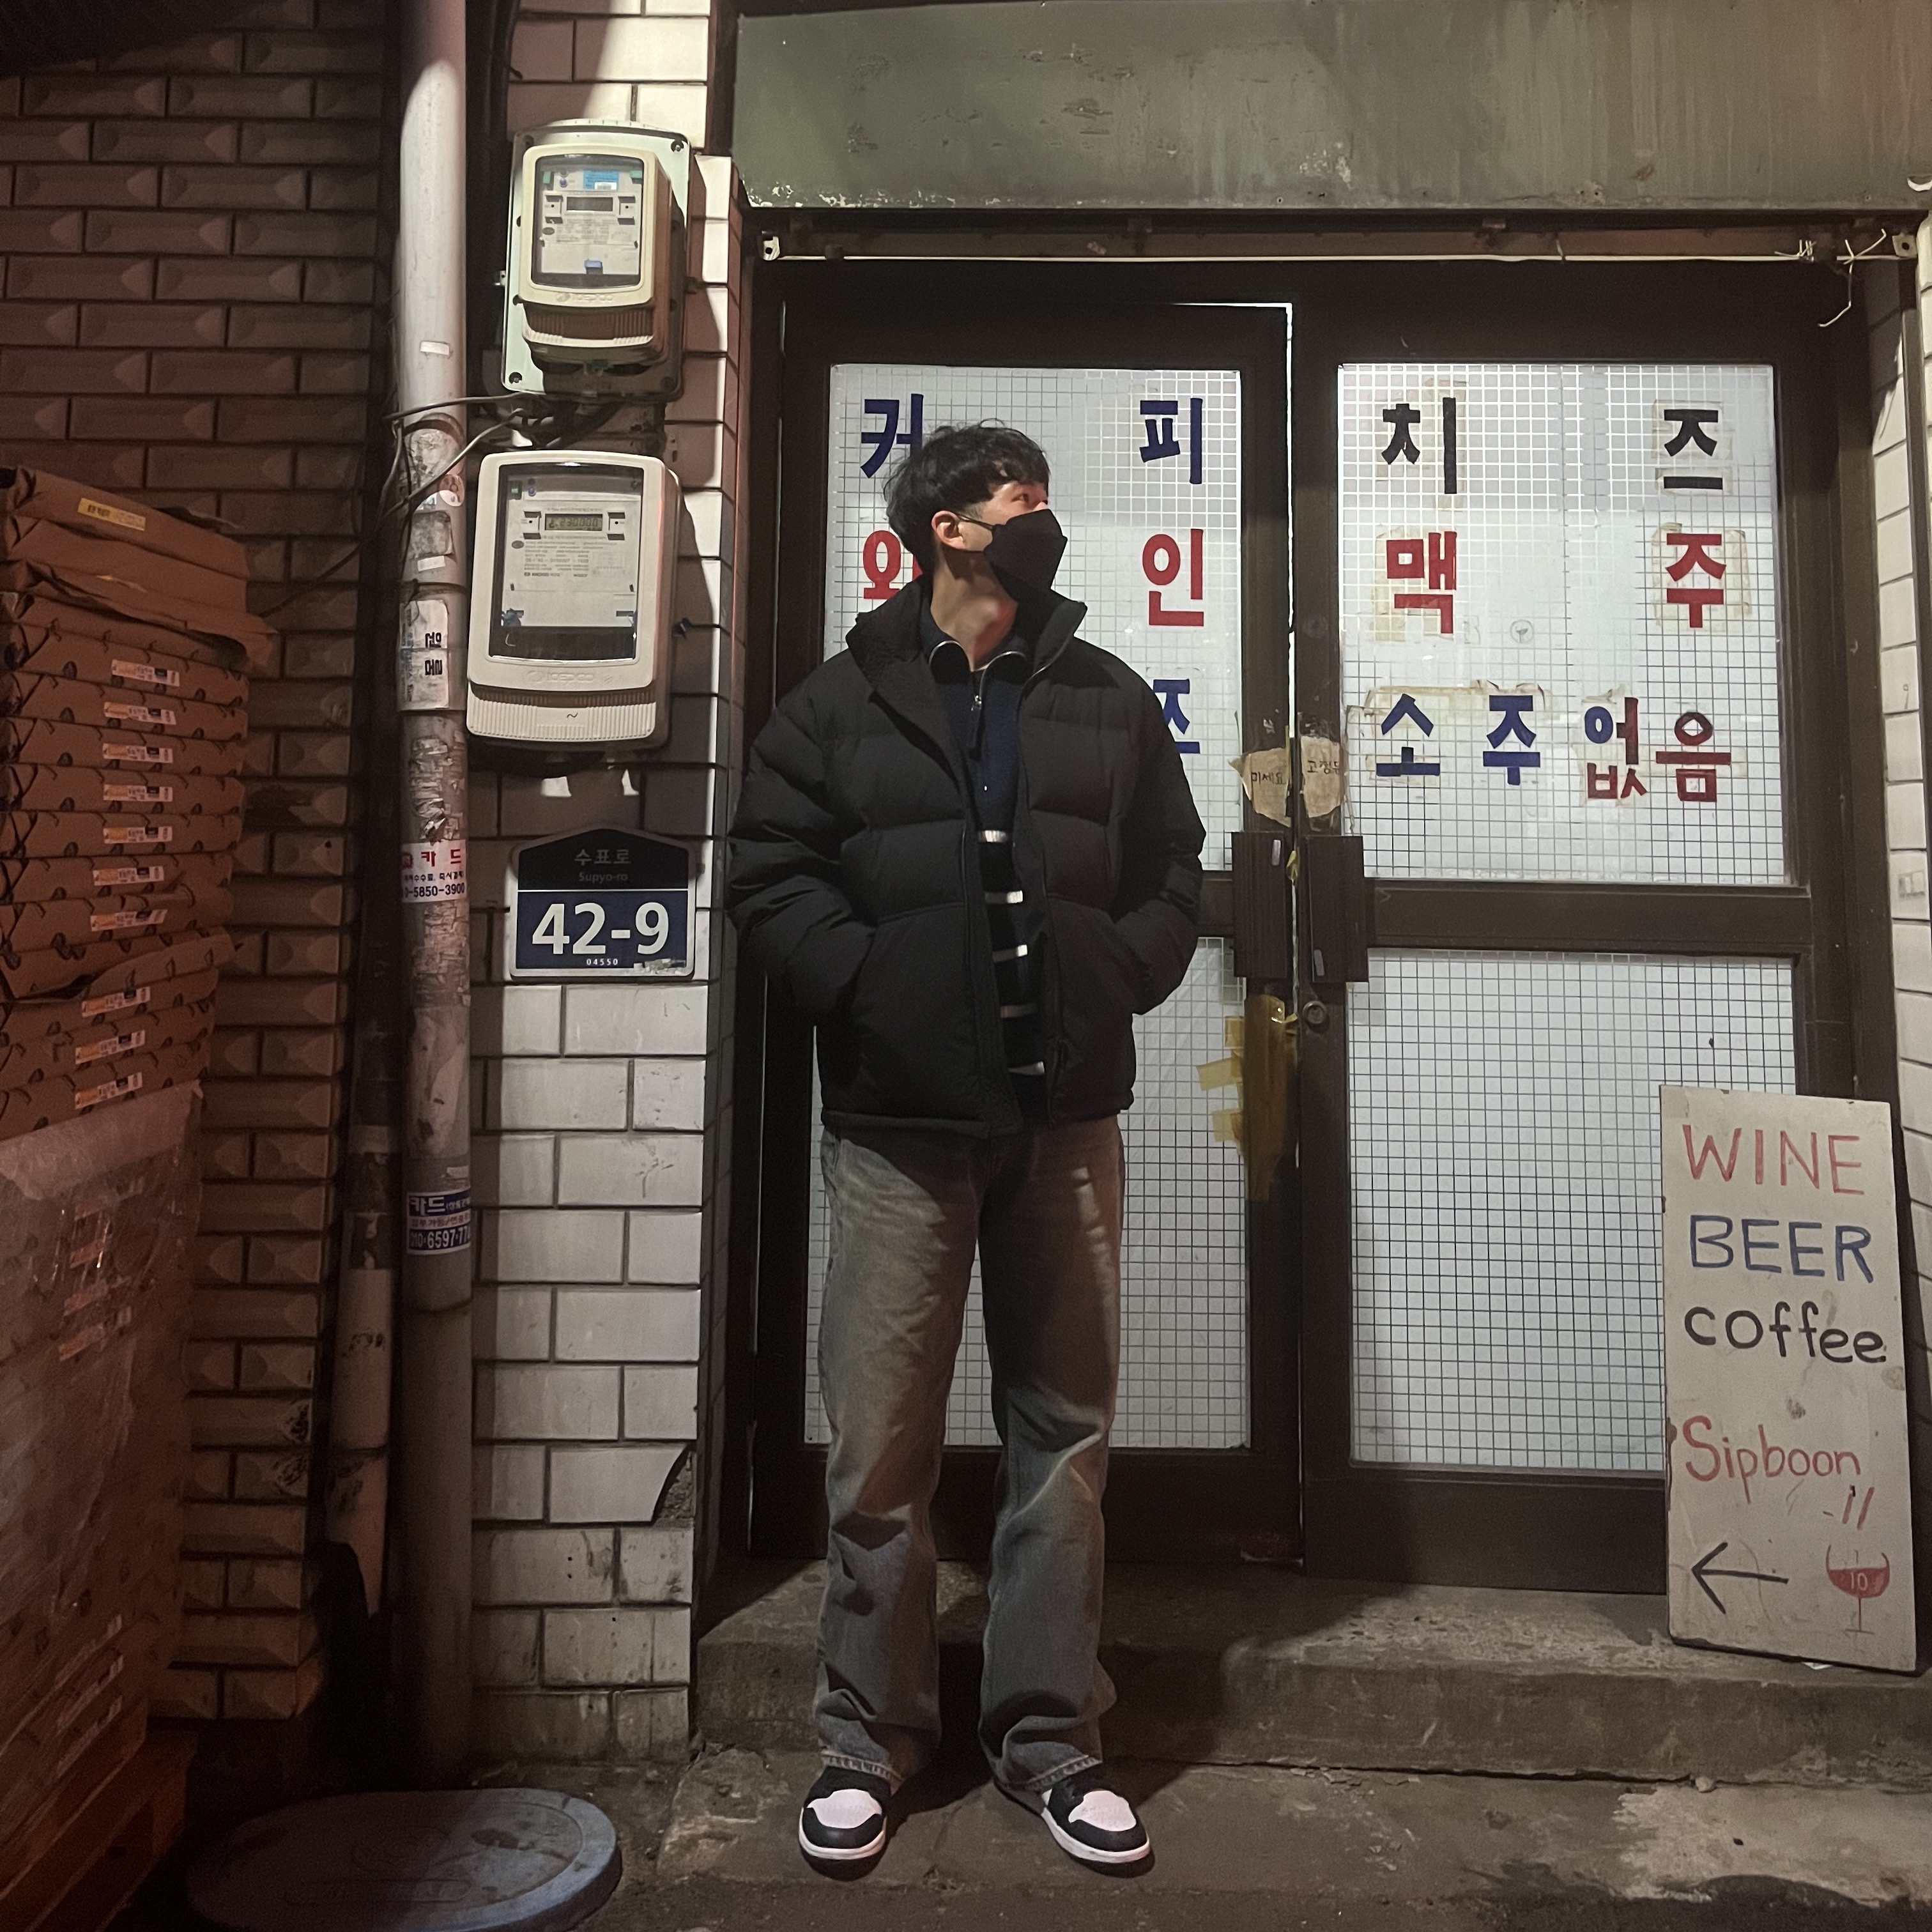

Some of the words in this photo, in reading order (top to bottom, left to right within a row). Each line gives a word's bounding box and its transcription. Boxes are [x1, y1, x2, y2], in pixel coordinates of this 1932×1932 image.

[1584, 696, 1732, 802] 없음
[574, 849, 632, 866] 수표로
[578, 872, 629, 885] Supyo-ro
[532, 902, 669, 955] 42-9
[1682, 1124, 1865, 1195] WINE
[1690, 1215, 1874, 1284] BEER
[1684, 1301, 1887, 1363] coffee
[1683, 1415, 1861, 1505] Sipboon
[1851, 1572, 1869, 1592] 10
